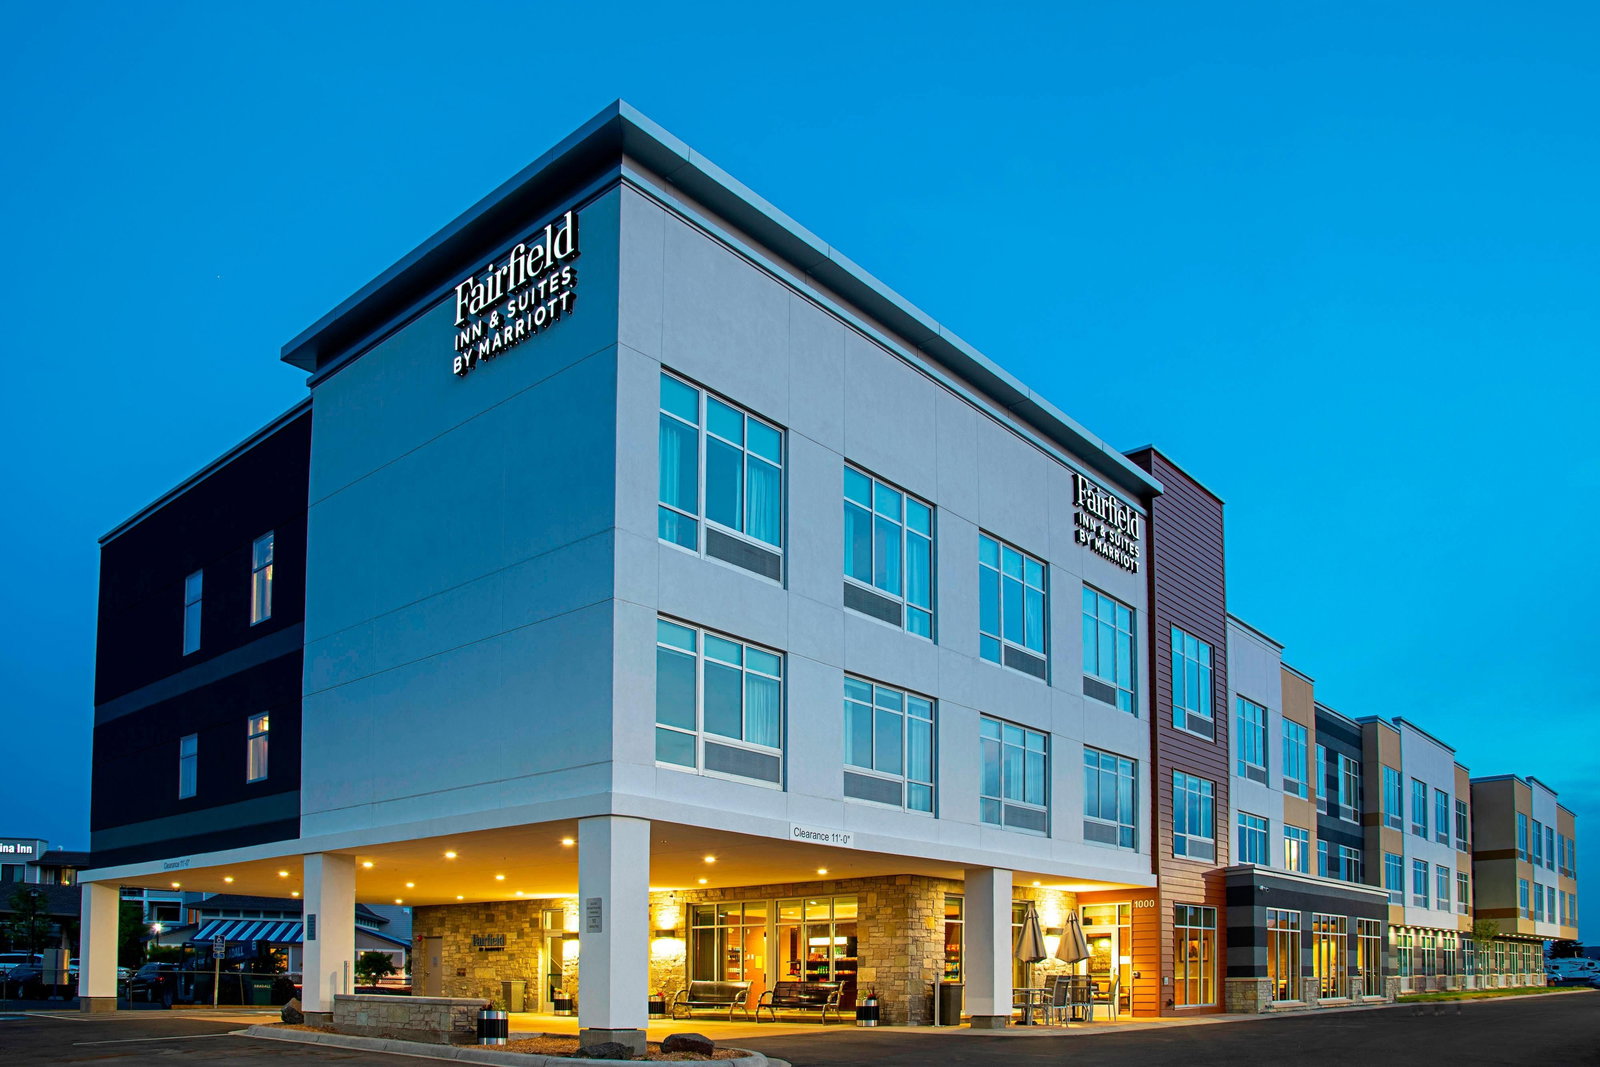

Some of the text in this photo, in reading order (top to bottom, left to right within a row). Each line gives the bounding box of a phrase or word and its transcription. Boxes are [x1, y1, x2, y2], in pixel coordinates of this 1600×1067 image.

[454, 210, 575, 326] Fairfield
[454, 265, 572, 351] INN & SUITES
[453, 290, 571, 374] BY MARRIOTT
[1077, 473, 1140, 540] Fairfield
[1079, 511, 1140, 558] INN & SUITES
[1079, 529, 1140, 573] BY MARRIOTT
[16, 843, 33, 854] Inn
[793, 826, 830, 842] Clearance
[1134, 899, 1155, 909] 1000
